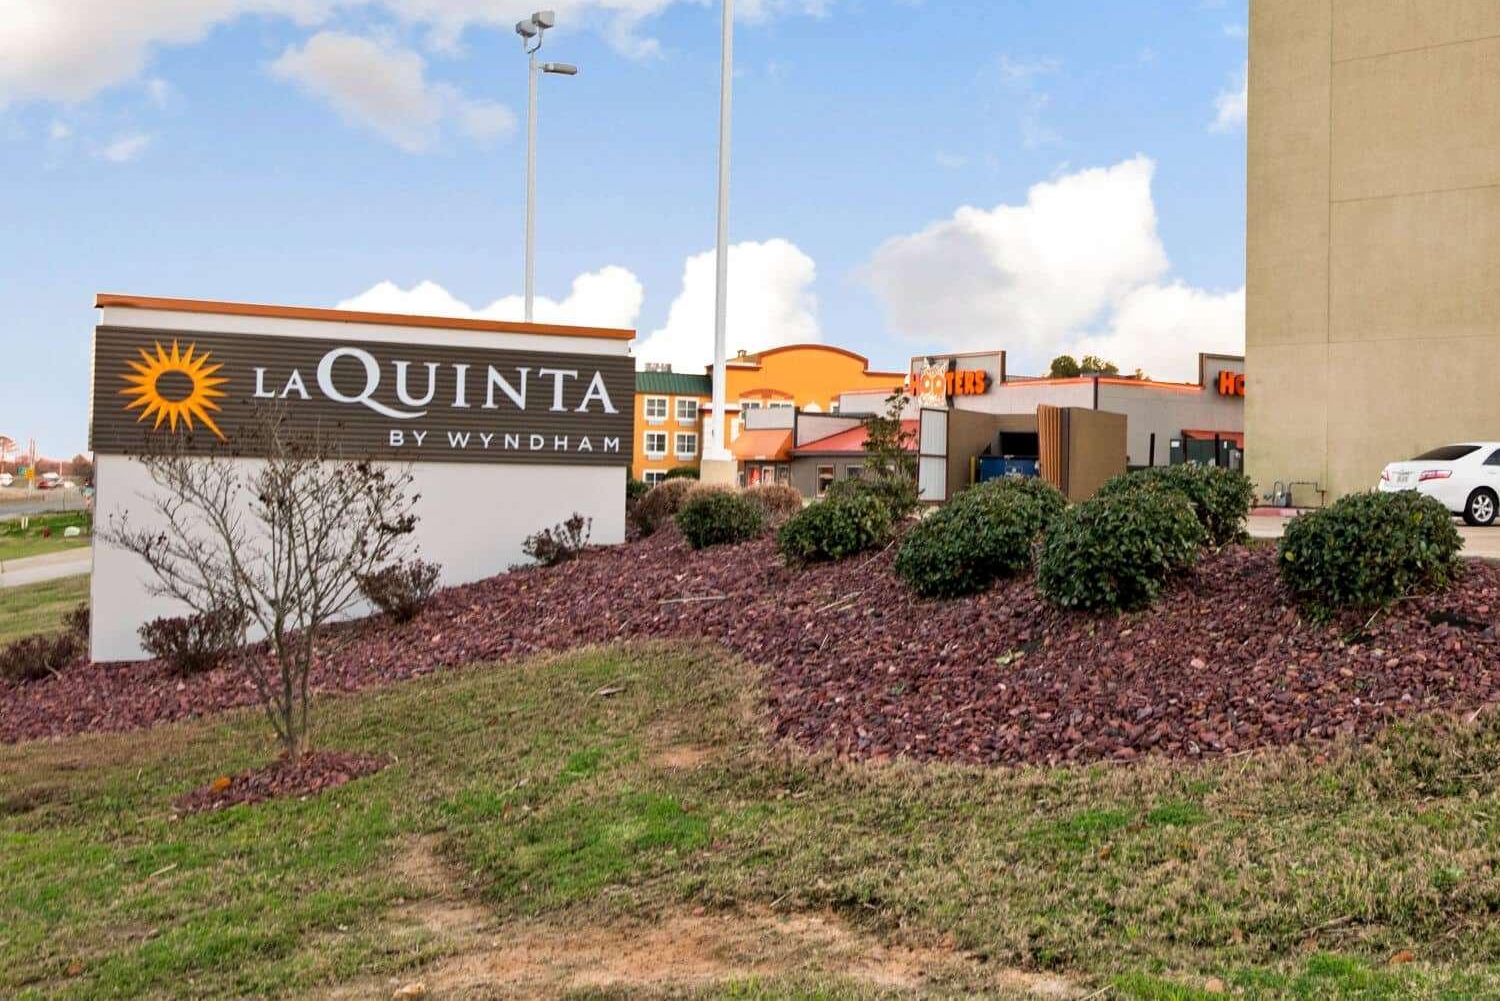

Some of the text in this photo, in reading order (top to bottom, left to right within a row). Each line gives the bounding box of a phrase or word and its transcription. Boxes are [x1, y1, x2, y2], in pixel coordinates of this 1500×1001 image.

[253, 347, 620, 419] LA QUINTA
[910, 370, 986, 397] HOOTERS
[389, 430, 620, 452] BY WYNDHAM
